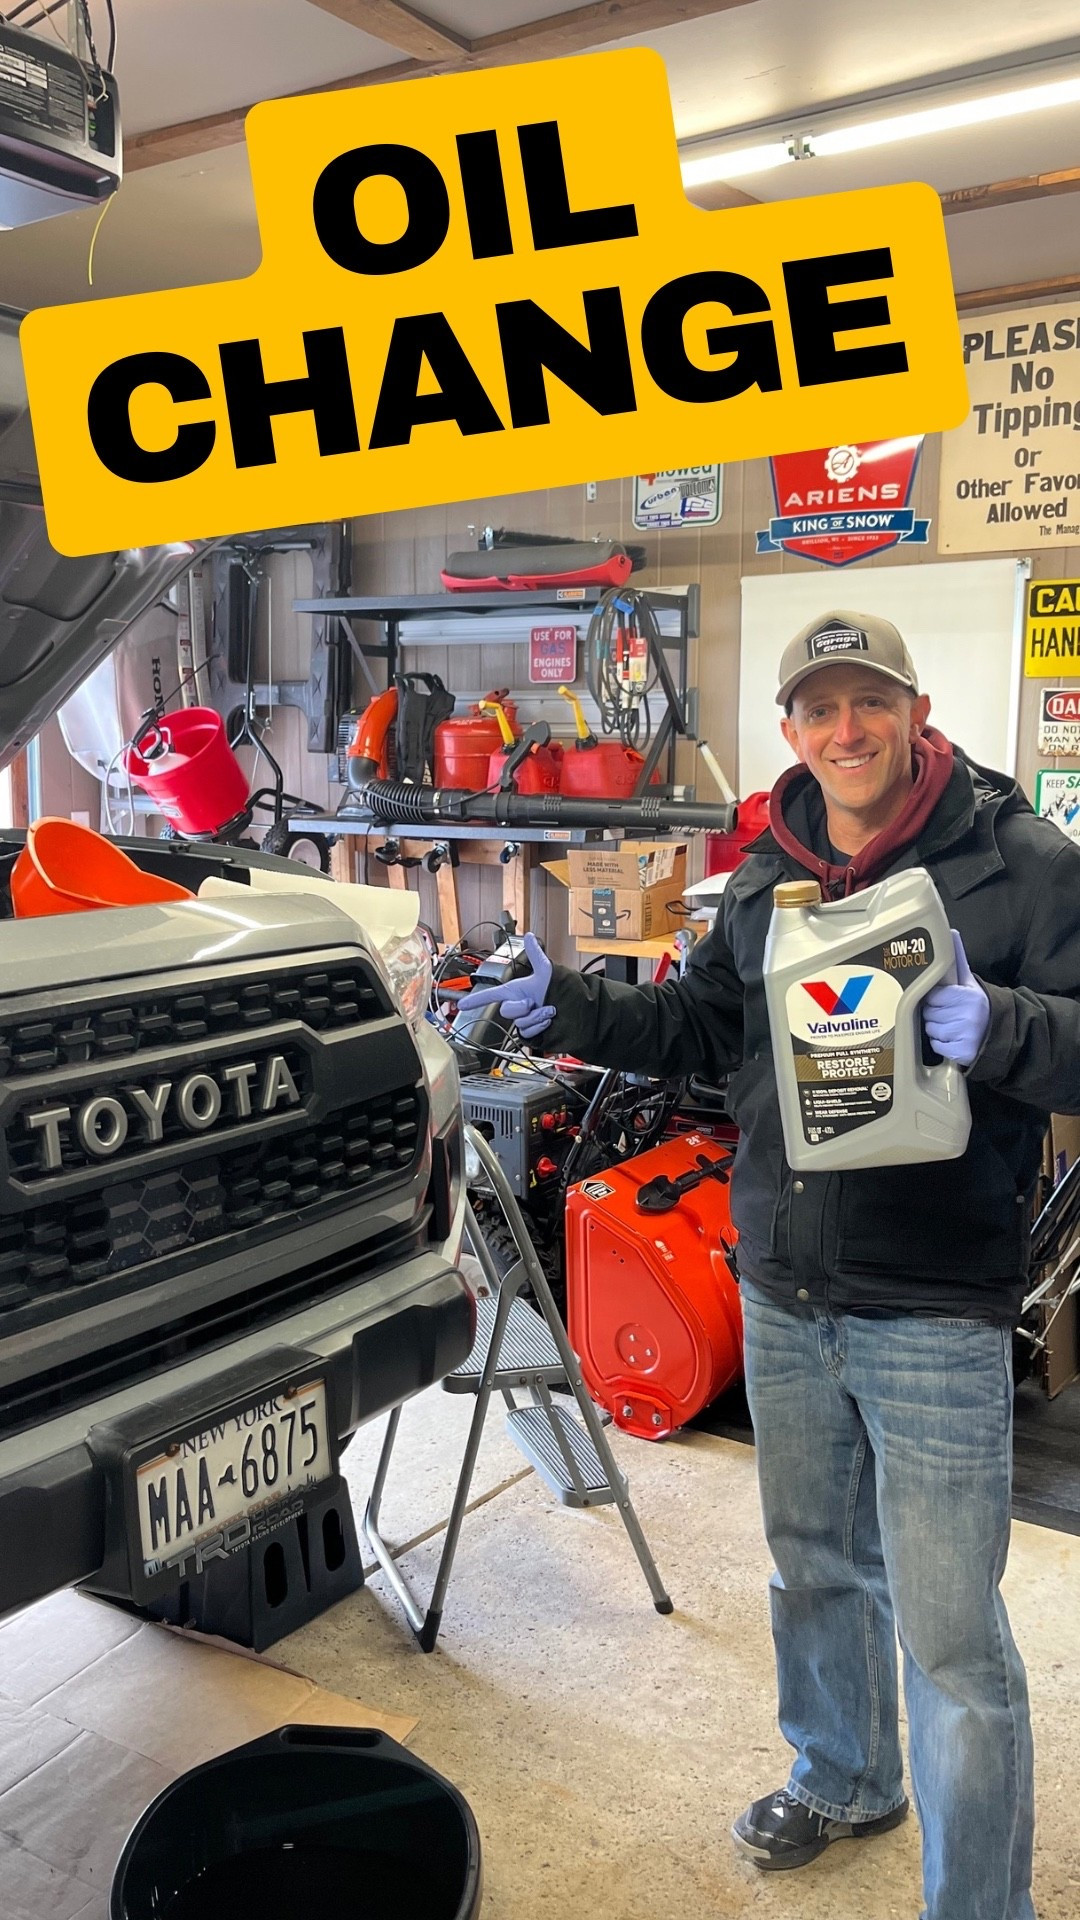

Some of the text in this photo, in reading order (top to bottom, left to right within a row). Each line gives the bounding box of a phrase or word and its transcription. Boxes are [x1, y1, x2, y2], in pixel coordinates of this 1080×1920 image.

[1010, 361, 1054, 394] No
[1014, 448, 1042, 467] Or
[648, 487, 677, 504] urban
[784, 483, 901, 508] ARIENS
[956, 479, 1012, 499] Other
[986, 497, 1068, 524] Allowed
[793, 514, 893, 533] KING OF SNOW
[1039, 525, 1052, 536] The
[534, 630, 572, 641] USE FOR
[816, 636, 858, 648] Garage
[541, 642, 566, 655] GAS
[823, 643, 852, 652] Gear
[533, 658, 571, 667] ENGINES
[541, 668, 564, 678] ONLY
[1052, 698, 1080, 715] DA
[1044, 725, 1058, 734] DO
[1046, 779, 1065, 788] KEEP
[890, 938, 926, 956] 0W-20
[884, 953, 928, 969] MOTOR OIL
[807, 1018, 879, 1034] Valvoline
[850, 1047, 881, 1055] SYNTHETIC
[822, 1066, 875, 1079] PROTECT
[28, 1056, 300, 1168] TOYOTA
[182, 1398, 283, 1458] NEW YORK
[148, 1400, 318, 1551] MAA 6875
[231, 1509, 304, 1554] TOYOTA RACING DEVELOPMENT
[166, 1518, 251, 1577] TRD
